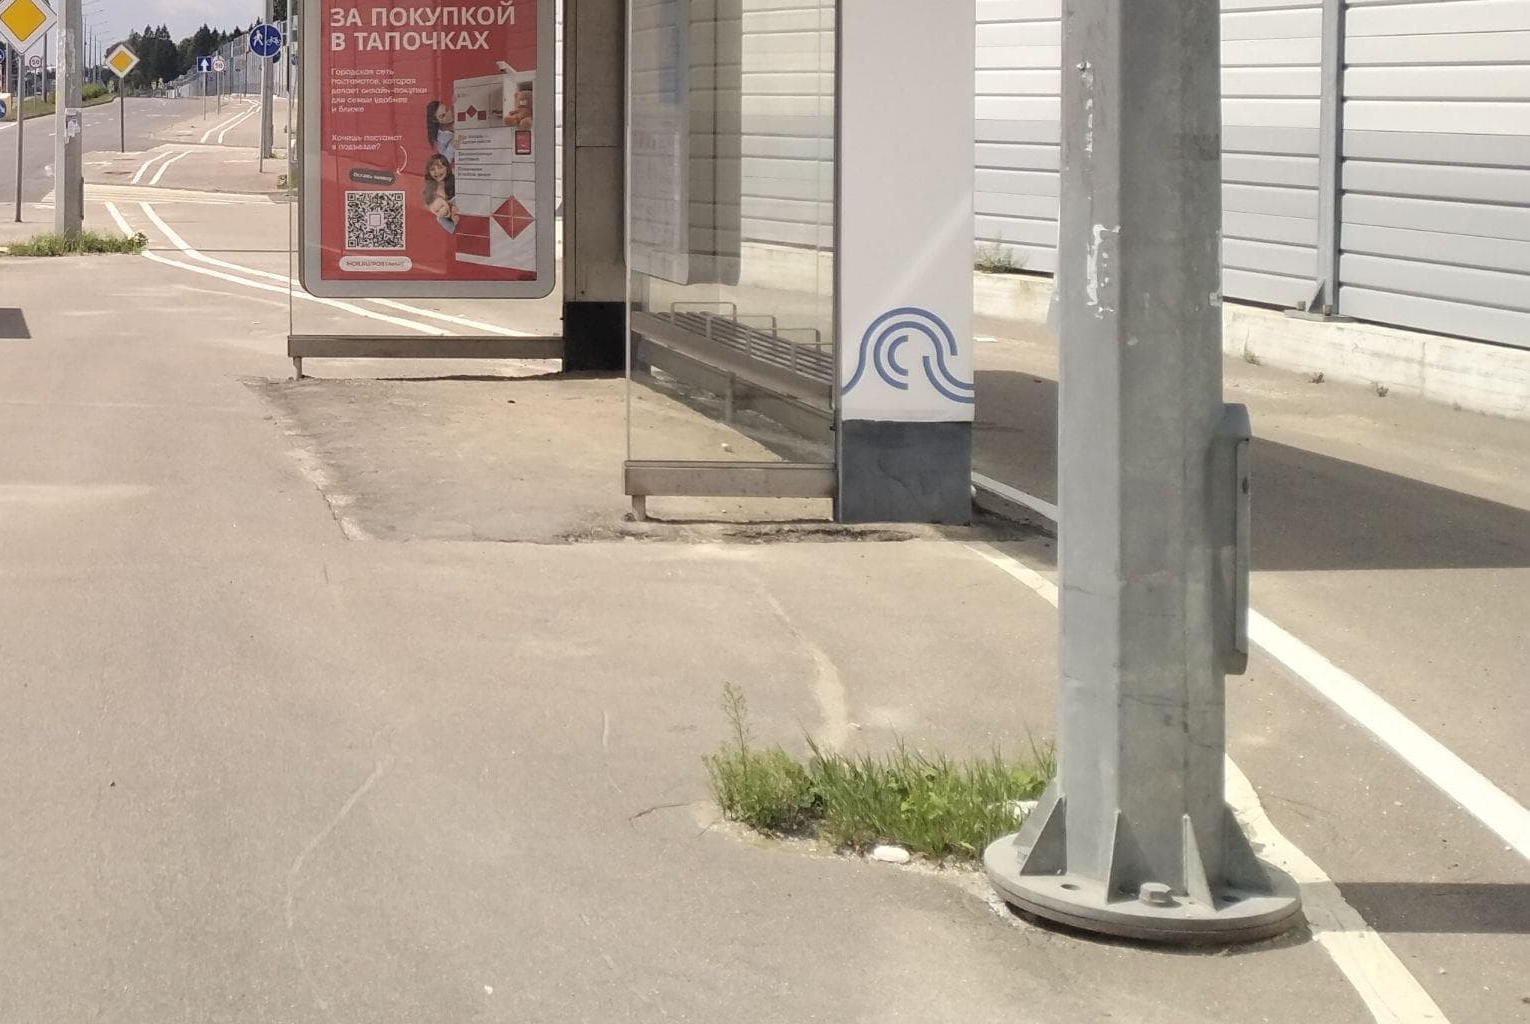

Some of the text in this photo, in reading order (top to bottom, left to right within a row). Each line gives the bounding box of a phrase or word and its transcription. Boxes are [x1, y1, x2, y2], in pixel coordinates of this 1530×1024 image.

[330, 0, 515, 27] ЗА ПОКУПКОЙ
[331, 30, 490, 51] В ТАПОЧКАХ
[331, 68, 374, 76] Городская
[331, 87, 359, 95] делает
[338, 142, 381, 151] подъезде?
